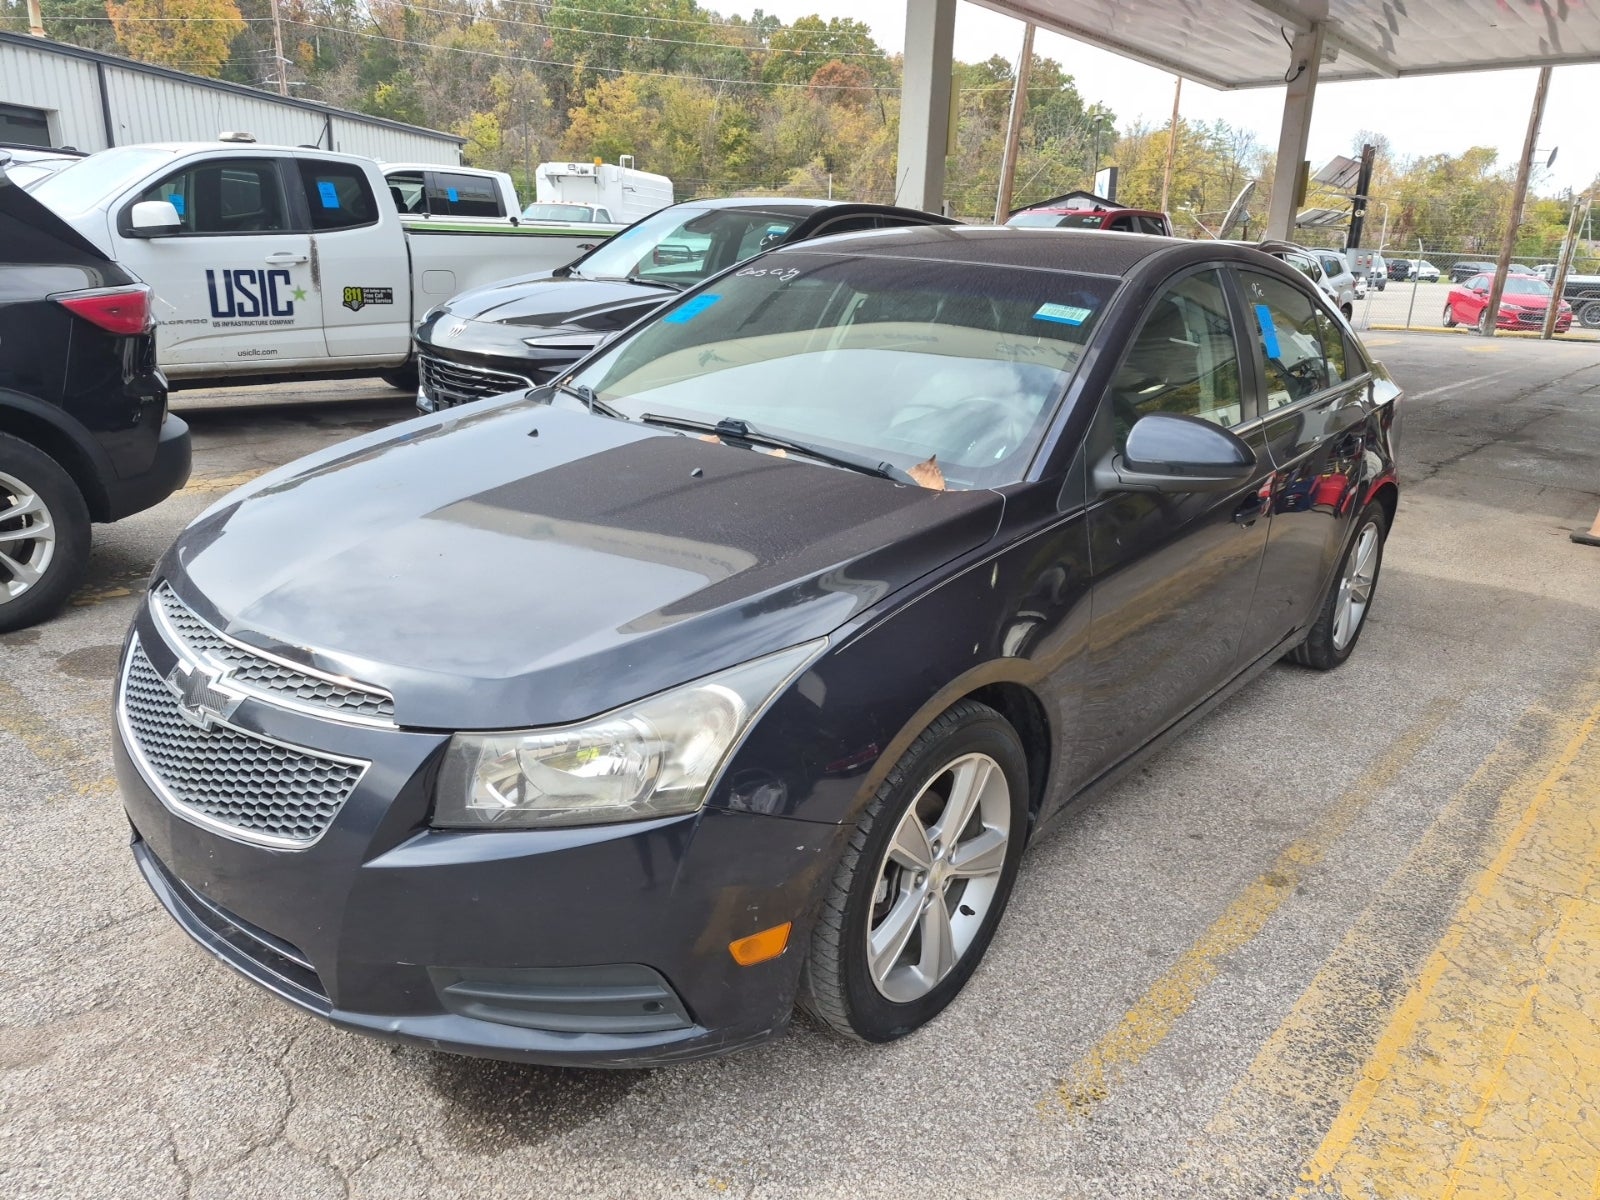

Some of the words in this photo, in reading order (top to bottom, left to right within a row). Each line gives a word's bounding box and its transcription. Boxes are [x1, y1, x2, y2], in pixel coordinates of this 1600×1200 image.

[205, 269, 294, 318] USIC
[344, 287, 362, 302] 811
[156, 318, 208, 326] OLORADO
[237, 348, 278, 357] usicllc.com
